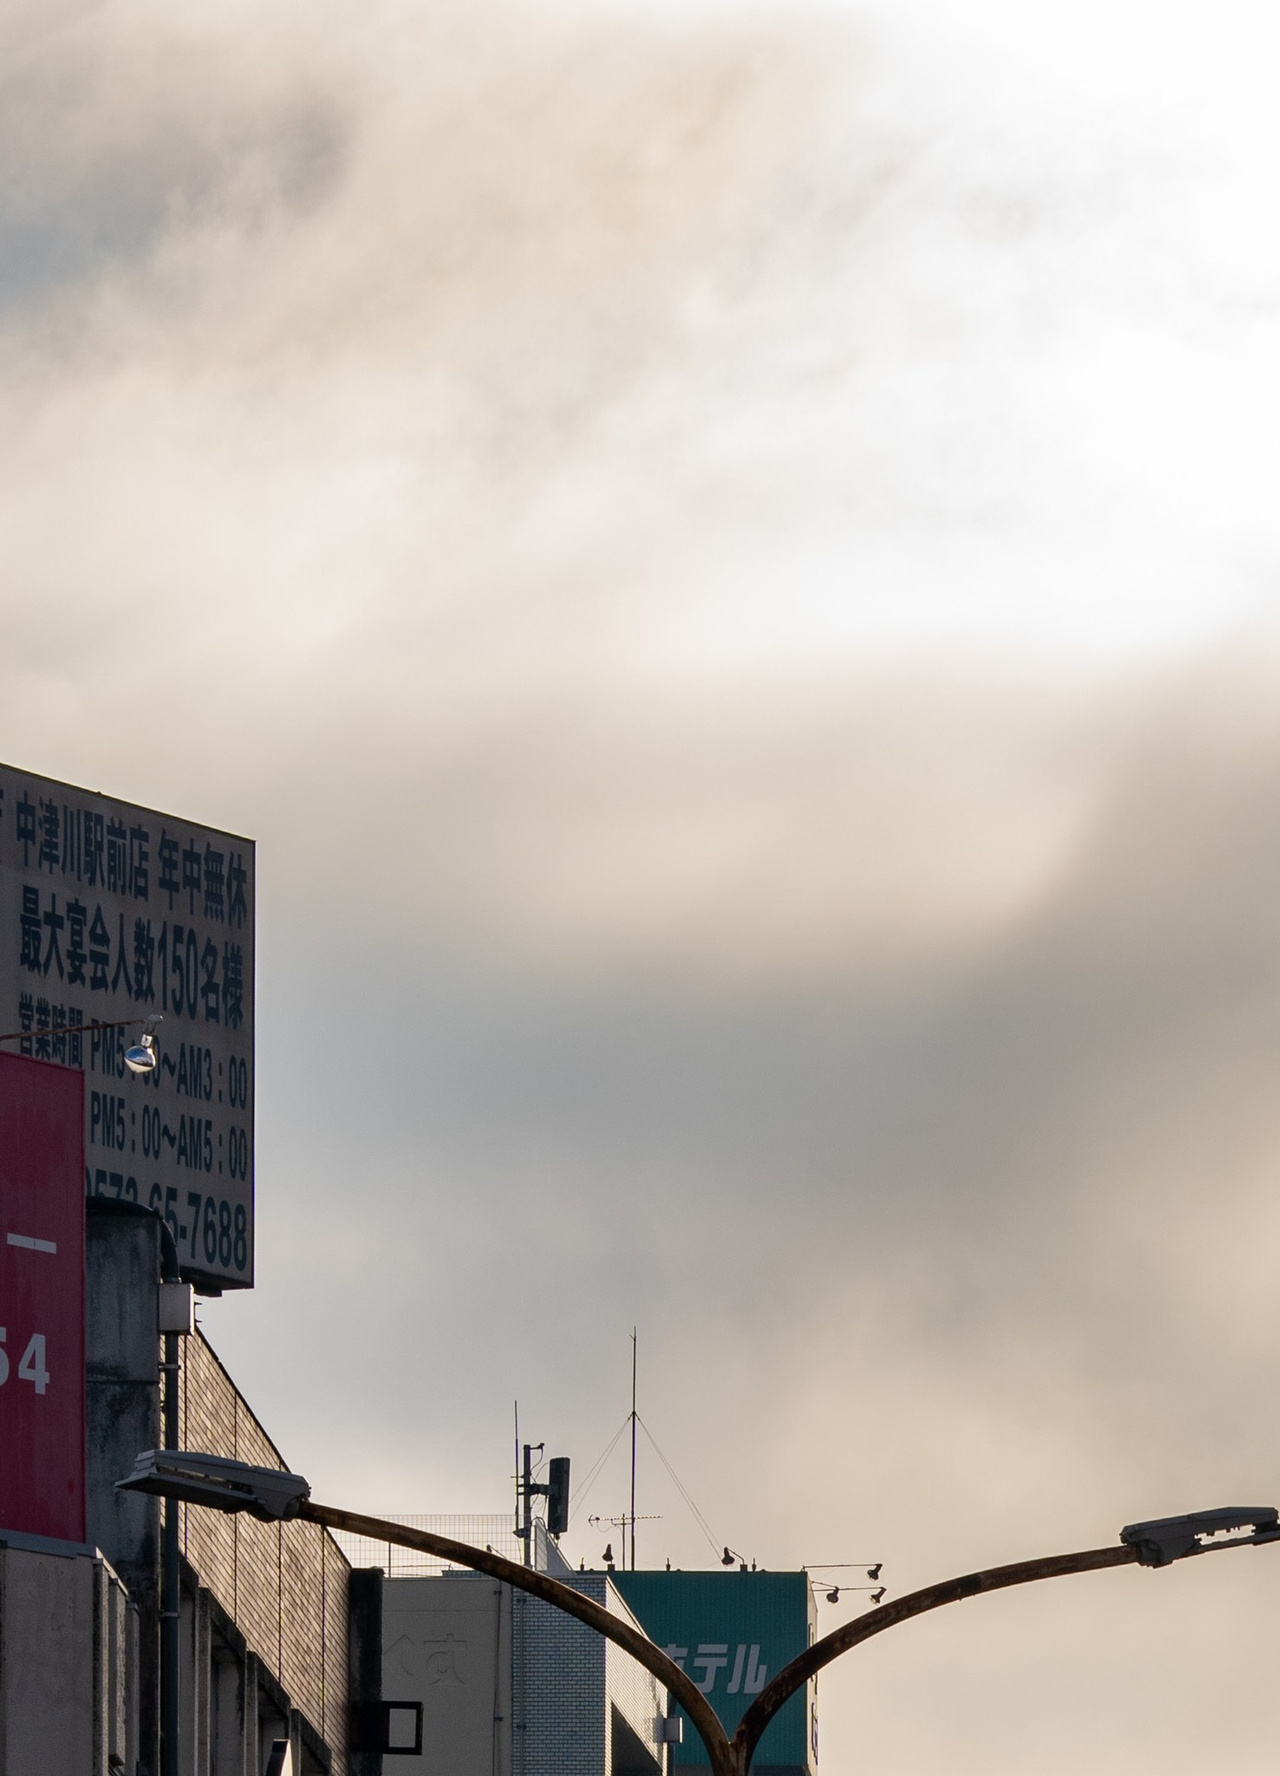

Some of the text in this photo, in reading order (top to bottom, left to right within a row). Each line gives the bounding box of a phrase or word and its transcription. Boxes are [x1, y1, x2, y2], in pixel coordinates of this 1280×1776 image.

[16, 790, 247, 929] 中津川駅前店 年中無休
[19, 885, 244, 1030] 最大宴会人数150名様
[18, 992, 84, 1069] 営業時間
